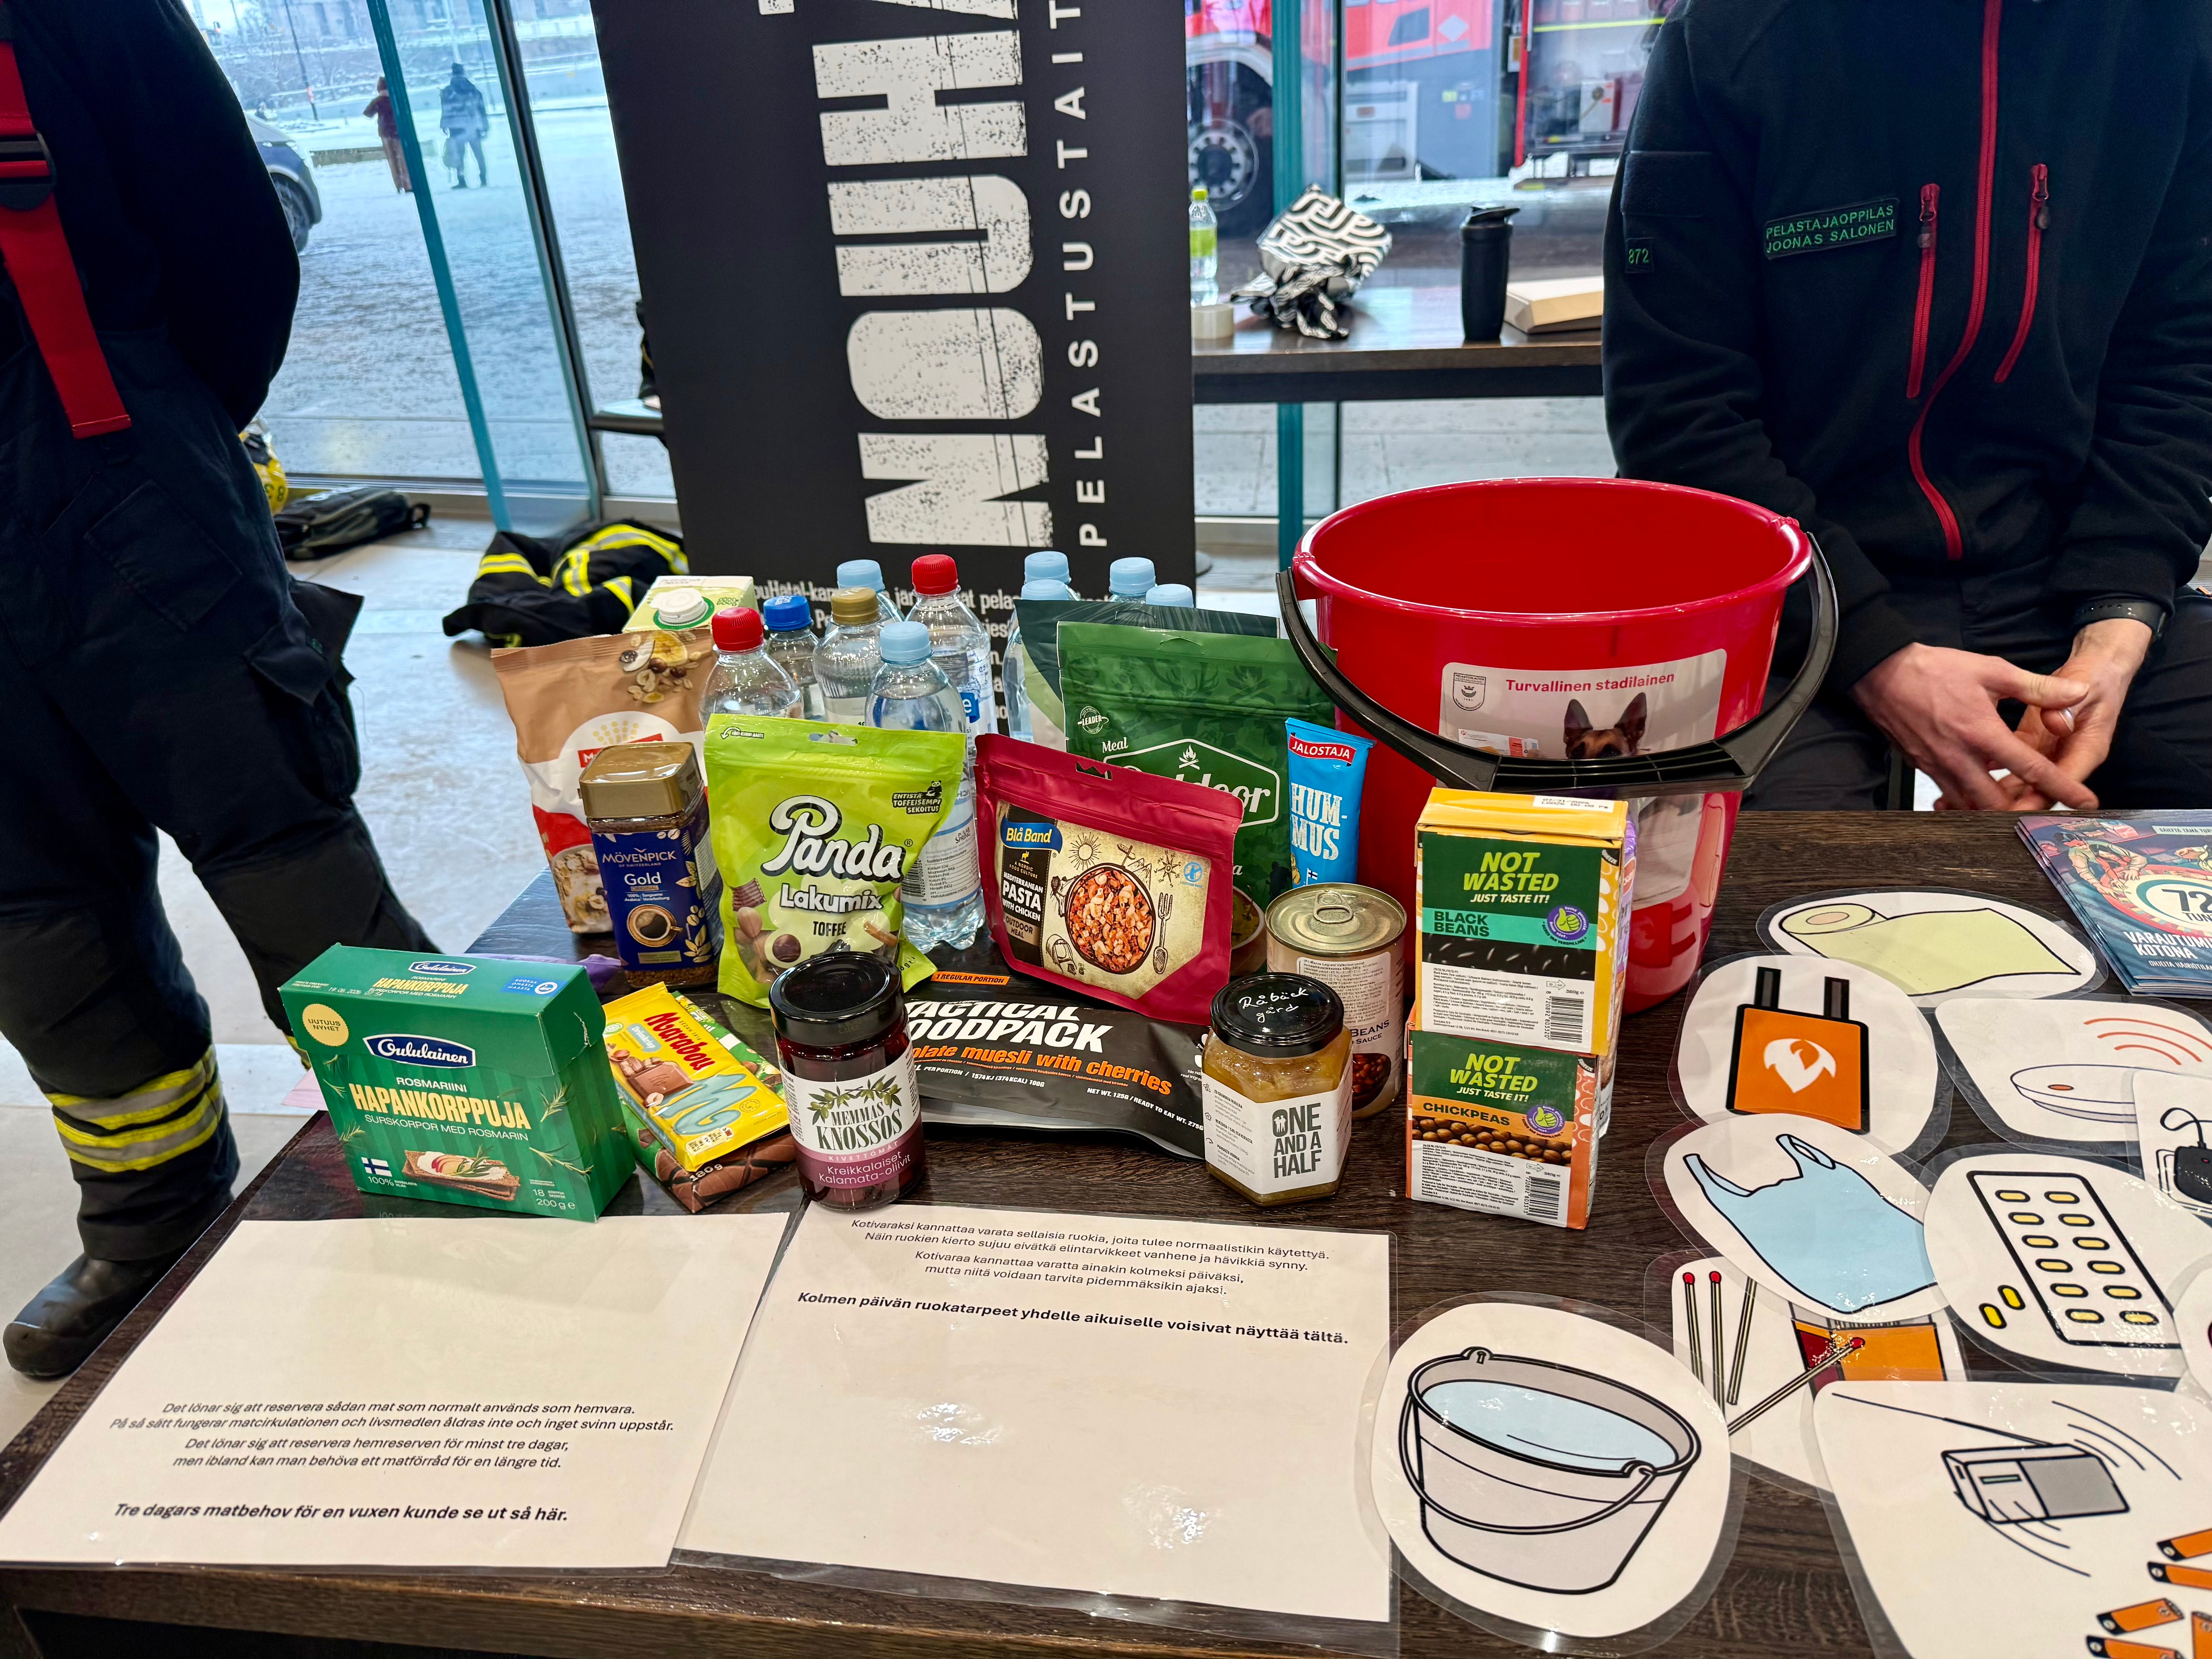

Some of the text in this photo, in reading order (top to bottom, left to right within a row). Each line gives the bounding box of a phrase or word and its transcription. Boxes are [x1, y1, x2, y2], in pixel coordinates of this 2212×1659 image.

[1766, 206, 1893, 239] PELASTAJAOPPILAS
[1767, 220, 1894, 253] JOONAS SALONEN
[1628, 248, 1649, 264] 872
[760, 0, 1053, 547] NOUH
[1506, 672, 1674, 692] Turvallinen stadilainen
[1082, 715, 1103, 726] LEADER
[1103, 737, 1128, 753] Meal
[1292, 743, 1350, 760] JALOSTAJA
[1291, 782, 1347, 827] HUM-
[761, 795, 905, 883] Panda
[1006, 827, 1052, 843] Blå Band
[1291, 823, 1340, 861] MUS
[603, 850, 677, 863] MÖVENPICK
[1018, 862, 1033, 872] NORDIC
[1480, 852, 1540, 873] NOT
[624, 872, 661, 885] Gold
[1004, 871, 1043, 893] MEDITERRANEAN
[1020, 867, 1038, 879] CULTURE
[1463, 873, 1559, 891] WASTED
[781, 883, 883, 913] Lakumix
[1003, 880, 1041, 912] PASTA
[1470, 893, 1549, 903] JUST TASTE IT!
[1002, 898, 1041, 922] WITH CHICKEN
[1434, 911, 1488, 926] BLACK
[813, 921, 847, 936] TOFFEE
[1006, 915, 1033, 934] OUTDOOR
[1011, 927, 1024, 938] MEAL
[1434, 921, 1490, 937] BEANS
[2133, 944, 2198, 959] KOTONA
[415, 963, 467, 973] Oululainen
[373, 977, 469, 994] HAPANKORPPUJA
[1239, 988, 1309, 1009] Råbäck
[308, 1018, 341, 1027] UUTUUS
[1256, 1004, 1299, 1023] gård
[632, 1026, 656, 1049] Drömkrisp
[907, 1018, 1113, 1053] OODPACK
[1350, 1020, 1389, 1037] BEANS
[1356, 1033, 1382, 1044] SAUCE
[378, 1039, 469, 1065] Oululainen
[644, 1012, 715, 1071] Marabou
[961, 1047, 1033, 1064] muesli
[1037, 1054, 1082, 1072] with
[1086, 1061, 1172, 1095] cherries
[1465, 1053, 1520, 1074] NOT
[396, 1077, 467, 1093] ROSMARIINI
[1450, 1068, 1538, 1092] WASTED
[1457, 1087, 1530, 1103] JUST TASTE IT!
[349, 1083, 532, 1130] HAPANKORPPUJA
[831, 1102, 884, 1126] MEMMAS
[1133, 1097, 1154, 1109] READY
[1164, 1110, 1175, 1119] EAT
[1176, 1116, 1187, 1124] WT.
[1188, 1121, 1204, 1131] 275G
[1423, 1103, 1510, 1126] CHICKPEAS
[365, 1114, 528, 1141] SURSKORPOR MED ROSMARIN
[816, 1108, 902, 1150] KNOSSOS
[1273, 1103, 1321, 1137] ONE
[1274, 1131, 1322, 1156] AND A
[819, 1154, 911, 1185] Kalamata-oliivit
[828, 1151, 902, 1175] Kreikkalaiset
[1274, 1149, 1322, 1178] HALF
[368, 1176, 394, 1186] 100%
[689, 1166, 713, 1182] 180
[536, 1198, 557, 1207] 200
[852, 1220, 914, 1229] Kotivaraksi
[917, 1223, 975, 1234] kannattaa
[1017, 1231, 1065, 1239] sellaisia
[1068, 1234, 1108, 1243] ruokia,
[1111, 1236, 1138, 1245] joita
[1176, 1240, 1264, 1254] normaalistikin
[1268, 1247, 1329, 1259] käytettyä.
[895, 1235, 938, 1243] ruokien
[942, 1237, 975, 1245] kierto
[978, 1240, 1011, 1249] sujuu
[1014, 1242, 1056, 1251] eivätkä
[1060, 1243, 1141, 1257] elintarvikkeet
[1144, 1252, 1196, 1261] vanhene
[1199, 1254, 1210, 1263] ja
[1215, 1255, 1264, 1266] hävikkiä
[1269, 1262, 1307, 1271] synny.
[798, 1292, 1348, 1343] Kolmen päivän ruokatarpeet yhdelle aikuiselle voisivat näyttää tältä.
[163, 1403, 187, 1413] Det
[188, 1403, 223, 1412] lönar
[223, 1403, 244, 1414] sig
[244, 1403, 263, 1412] att
[326, 1401, 366, 1411] sådan
[368, 1403, 395, 1411] mat
[428, 1403, 481, 1412] normalt
[483, 1403, 539, 1412] används
[574, 1404, 634, 1414] hemvara.
[115, 1504, 567, 1521] Tre dagars matbehov för en vuxen kunde se ut så här.
